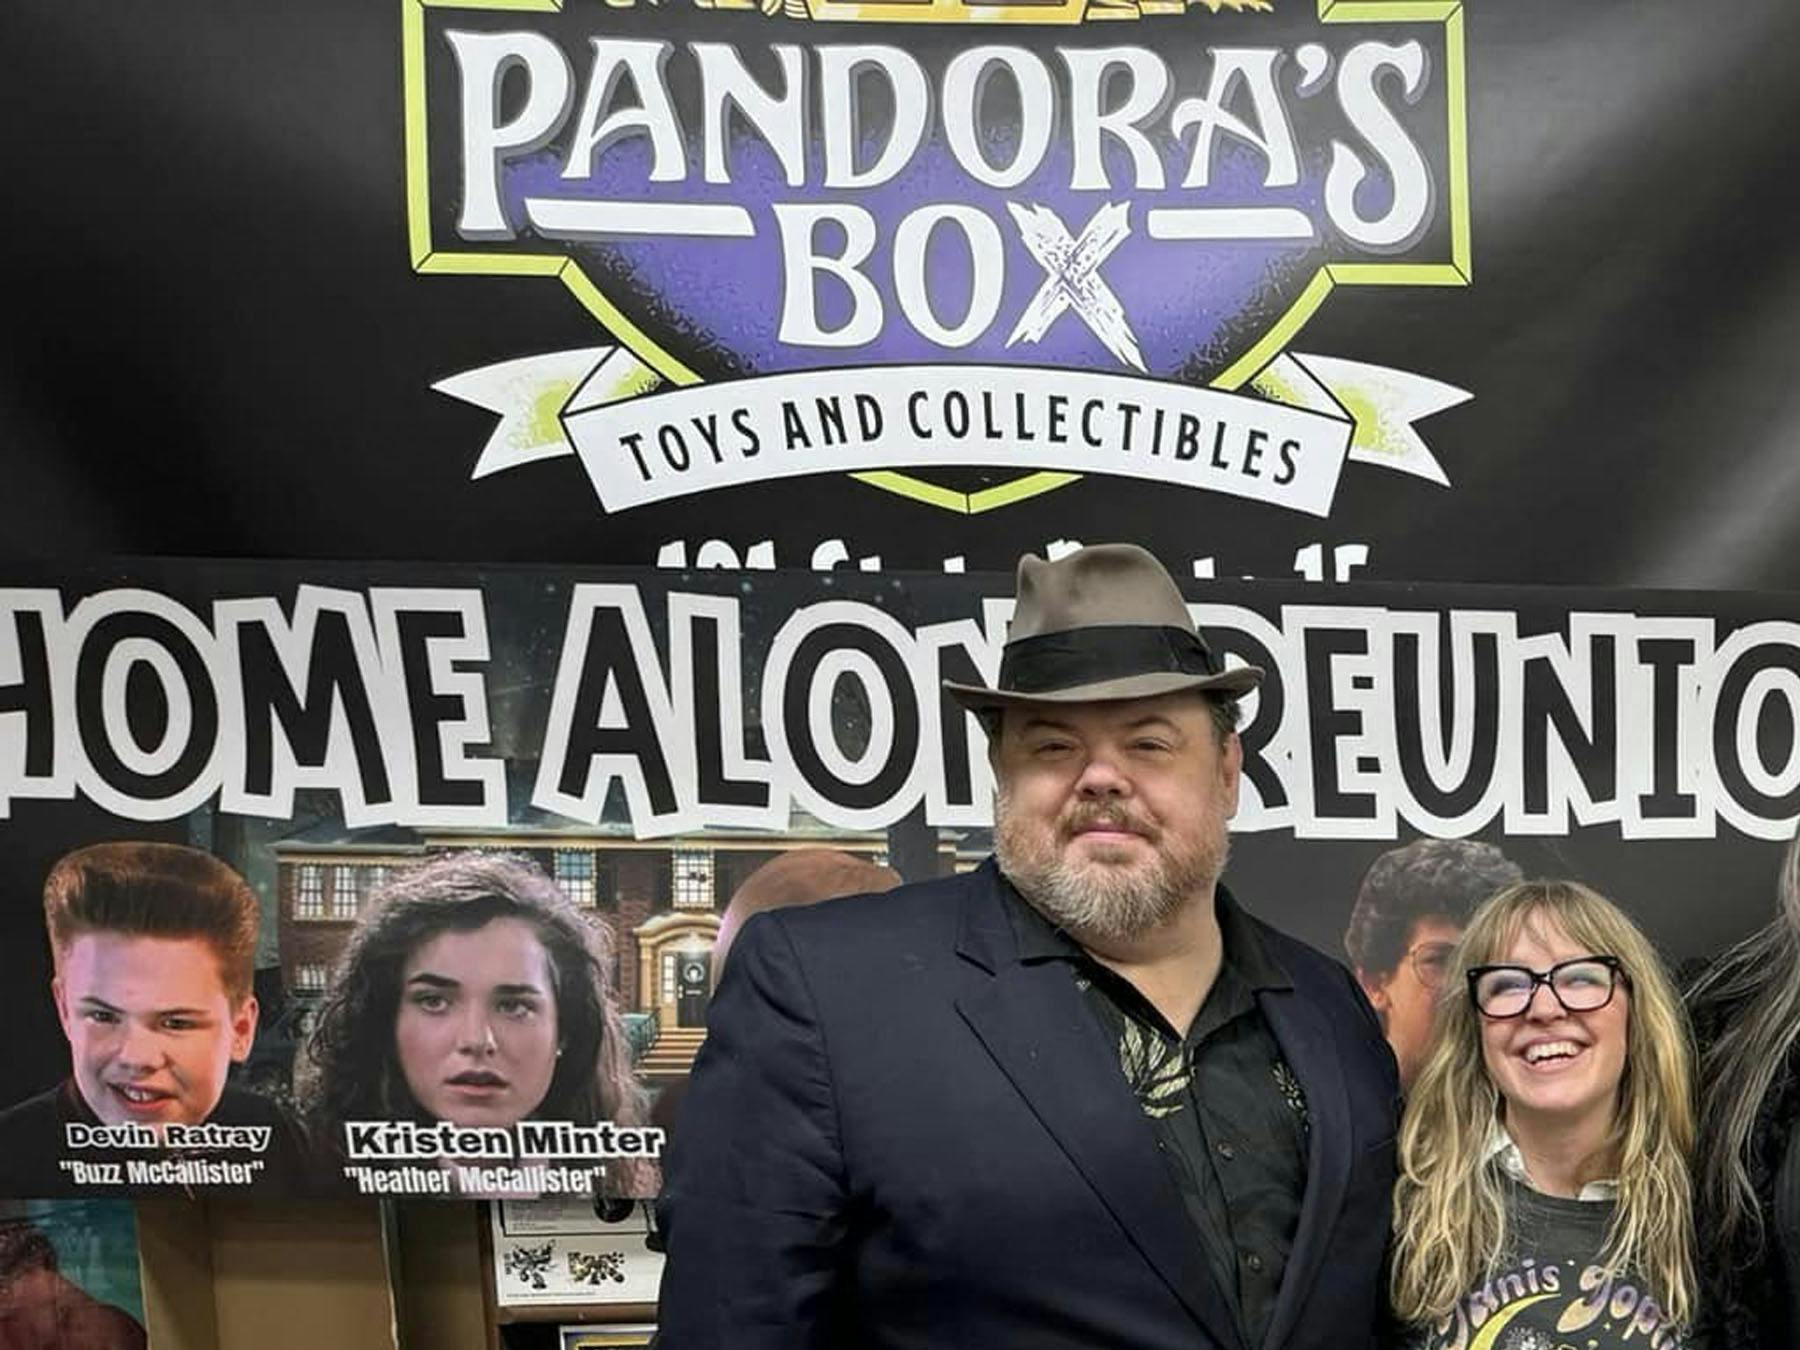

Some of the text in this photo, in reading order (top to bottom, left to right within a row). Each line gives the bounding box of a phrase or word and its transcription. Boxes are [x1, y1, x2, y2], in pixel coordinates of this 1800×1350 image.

[445, 30, 1427, 248] PANDORA'S
[776, 200, 1148, 373] BOX
[619, 391, 1304, 487] TOYS AND COLLECTIBLES
[0, 585, 508, 826] HOME
[66, 1121, 271, 1151] Devin Ratray
[345, 1121, 666, 1159] Kristen Minter
[59, 1159, 264, 1185] "Buzz McCallister"
[344, 1165, 605, 1194] "Heather McCallister"
